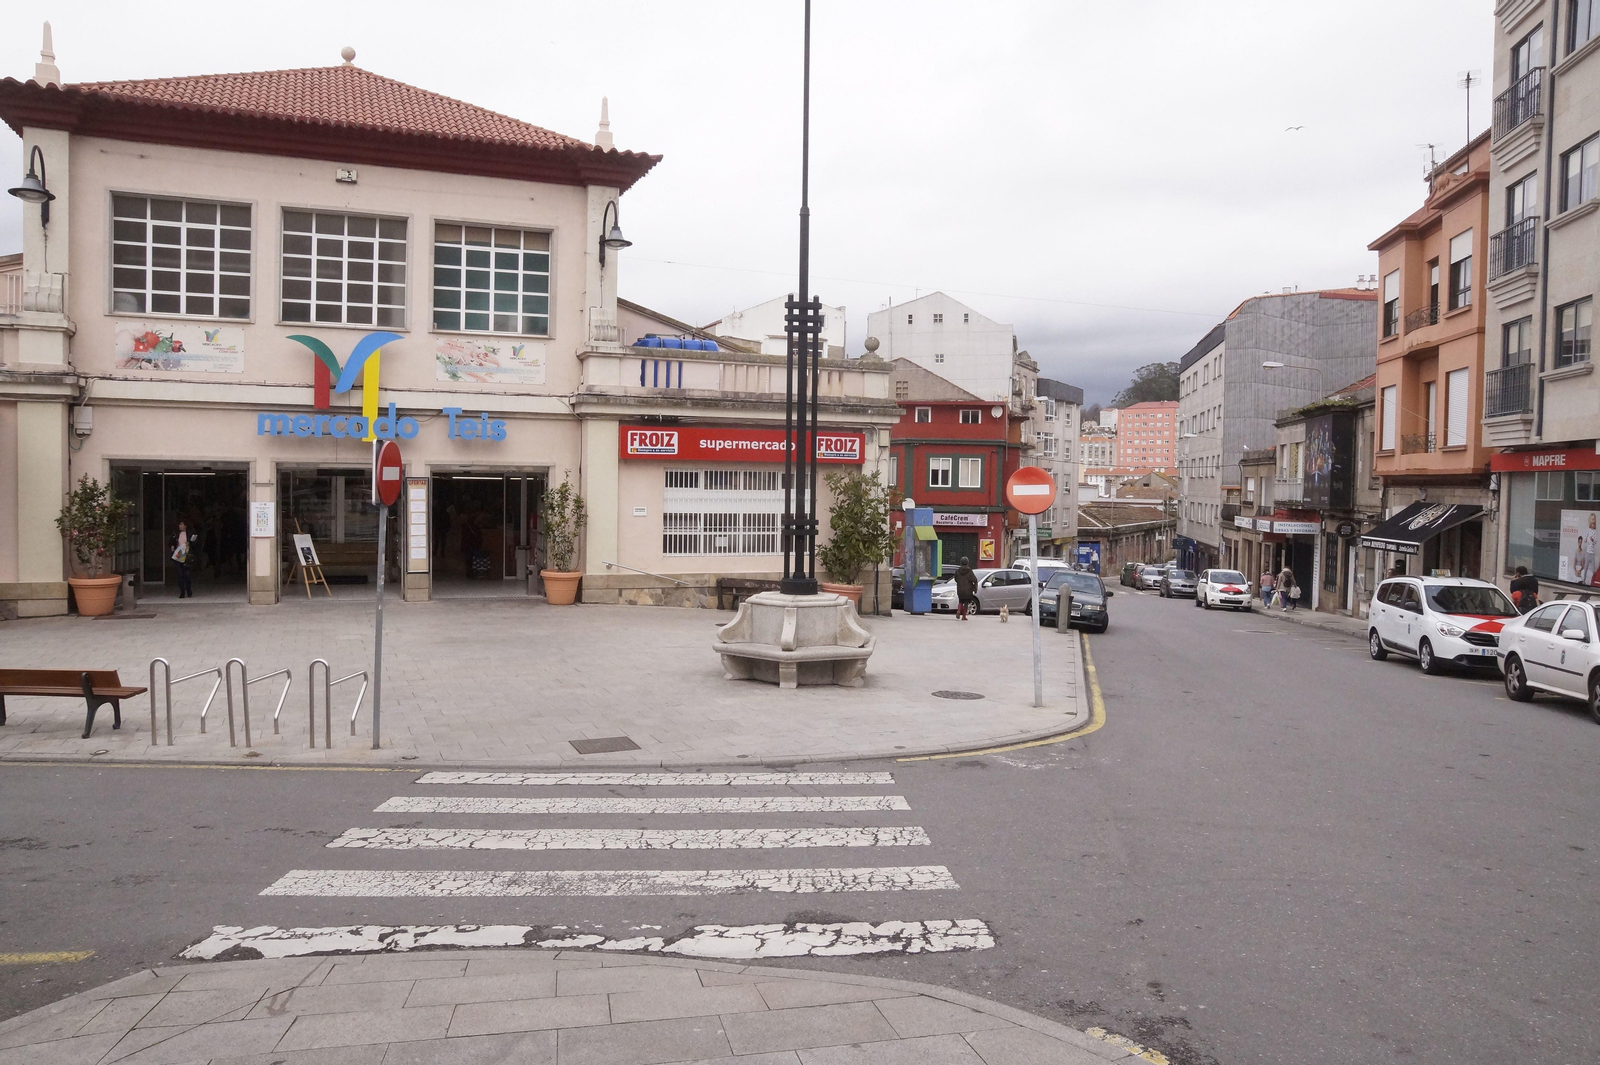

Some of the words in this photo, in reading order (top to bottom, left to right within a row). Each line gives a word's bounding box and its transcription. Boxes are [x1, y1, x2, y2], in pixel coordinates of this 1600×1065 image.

[257, 402, 420, 440] mercado
[442, 407, 507, 441] Teis
[630, 432, 675, 447] FROIZ
[700, 439, 796, 451] supermercado
[818, 438, 857, 452] FROIZ
[1532, 454, 1566, 467] MAPFRE
